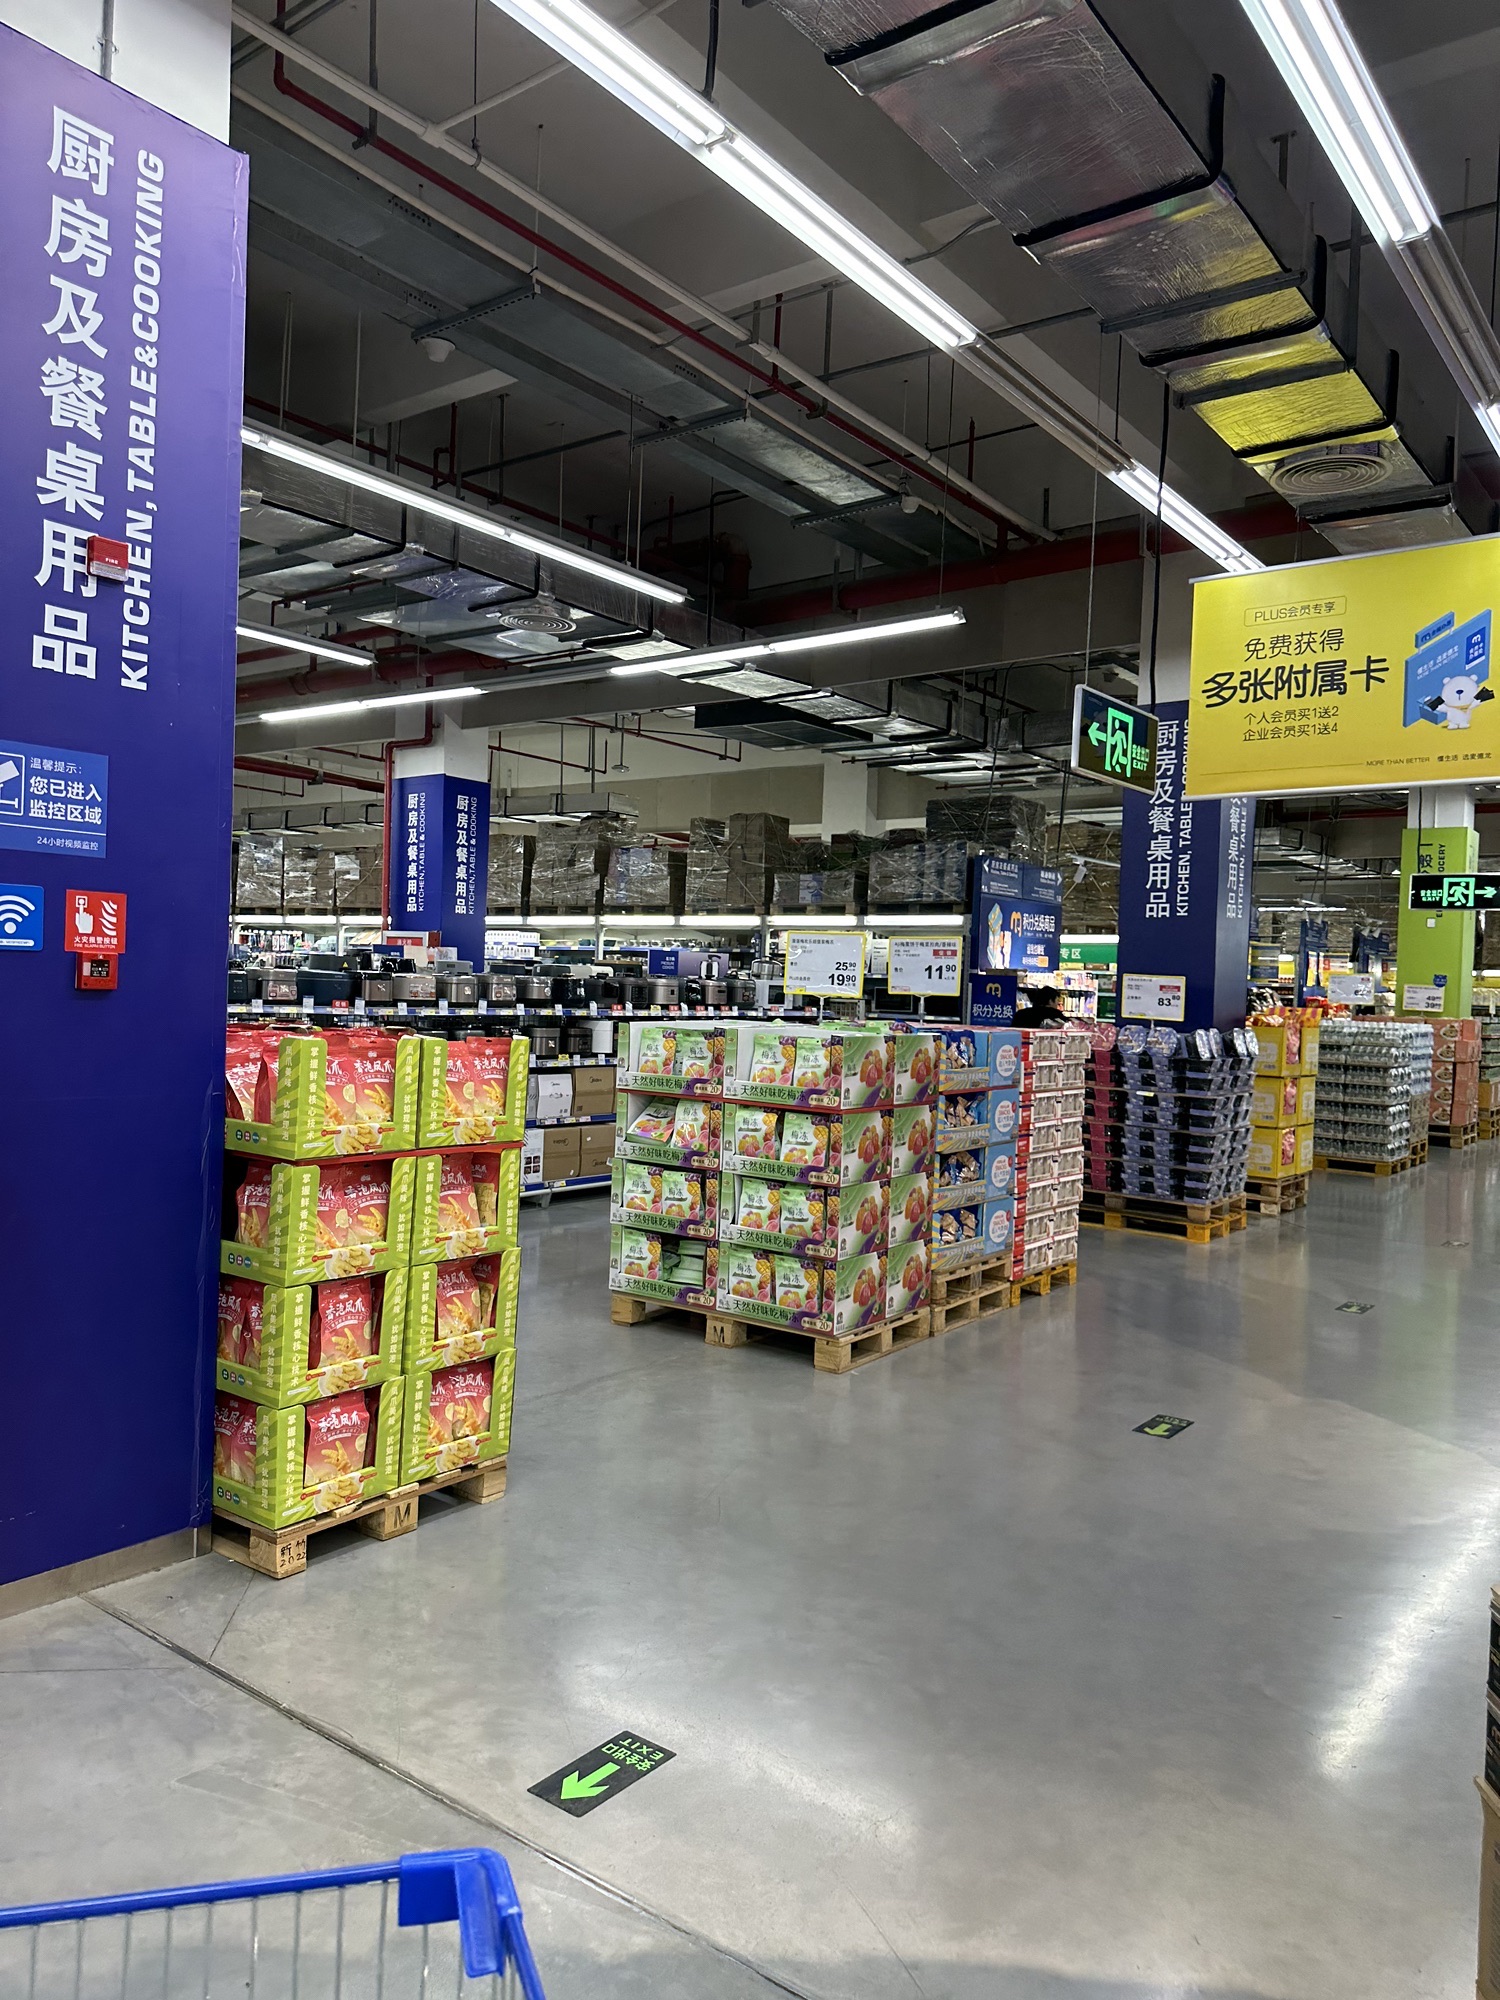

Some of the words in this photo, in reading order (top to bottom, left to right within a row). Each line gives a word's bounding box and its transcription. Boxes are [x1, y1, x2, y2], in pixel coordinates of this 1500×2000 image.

[32, 105, 115, 680] 厨房及餐桌用品
[105, 557, 119, 565] FIRE
[121, 501, 158, 692] KITCHEN,
[1254, 602, 1336, 623] PLUS会员专享
[1244, 628, 1345, 662] 免费获得
[1201, 655, 1390, 709] 多张附属卡
[1243, 705, 1340, 726] 个人会员买1送2
[1242, 722, 1339, 742] 企业会员买1送4
[1132, 759, 1148, 772] EXIT
[1406, 757, 1430, 765] BETTER
[29, 776, 103, 803] 您已进入
[28, 799, 103, 825] 监控区域
[419, 792, 427, 832] COOKING
[470, 796, 478, 835] COOKING
[1145, 720, 1179, 918] 厨房及餐桌用品
[1179, 802, 1194, 848] TABLE
[36, 836, 99, 851] 24小时视频监控
[406, 793, 419, 912] 厨房及餐桌用品
[454, 794, 469, 914] 厨房及餐桌用品
[1176, 850, 1193, 917] KITCHEN,
[1023, 913, 1056, 932] 积分兑换商品
[74, 936, 118, 945] 火灾报警按钮
[1060, 948, 1082, 960] 专区
[972, 1003, 1014, 1018] 积分兑换
[689, 1046, 705, 1056] 梅冻
[761, 1050, 777, 1060] 梅冻
[802, 1054, 820, 1064] 梅冻
[354, 1059, 395, 1074] 香泡凤爪
[473, 1057, 508, 1071] 香泡凤爪
[307, 1047, 319, 1140] 掌握鲜香核心技术
[430, 1046, 442, 1131] 掌握鲜香核心技术
[632, 1075, 692, 1091] 天然好味吃梅冻
[709, 1085, 718, 1094] 20
[740, 1084, 806, 1102] 天然好味吃梅冻
[826, 1096, 835, 1106] 20
[683, 1106, 698, 1117] 梅冻
[742, 1117, 759, 1127] 梅冻
[791, 1130, 809, 1141] 梅冻
[630, 1145, 688, 1163] 天然好味吃梅冻
[706, 1158, 715, 1167] 20
[740, 1159, 806, 1178] 天然好味吃梅冻
[825, 1174, 835, 1183] 20
[344, 1181, 392, 1199] 香泡凤爪
[632, 1179, 648, 1190] 梅冻
[668, 1186, 684, 1197] 梅冻
[421, 1162, 435, 1248] 掌握鲜香核心技术
[747, 1193, 764, 1204] 梅冻
[296, 1173, 311, 1268] 掌握鲜香核心技术
[787, 1206, 804, 1218] 梅冻
[625, 1211, 684, 1232] 天然好味吃梅冻
[702, 1227, 711, 1237] 20
[629, 1245, 644, 1255] 梅冻
[736, 1229, 803, 1251] 天然好味吃梅冻
[823, 1248, 832, 1257] 20
[736, 1262, 753, 1274] 梅冻
[782, 1272, 801, 1284] 梅冻
[624, 1277, 685, 1299] 天然好味吃梅冻
[702, 1297, 711, 1306] 20
[326, 1297, 365, 1320] 香泡凤爪
[419, 1271, 431, 1358] 掌握鲜香核心技术
[733, 1299, 799, 1324] 天然好味吃梅冻
[819, 1321, 828, 1331] 20
[290, 1293, 304, 1388] 掌握鲜香核心技术
[713, 1325, 726, 1344] M
[318, 1410, 361, 1433] 香泡凤爪
[411, 1380, 424, 1466] 掌握鲜香核心技术
[285, 1414, 297, 1508] 掌握鲜香核心技术
[393, 1502, 411, 1529] M
[279, 1551, 306, 1568] 2022
[601, 1743, 656, 1772] 安全出口
[619, 1738, 665, 1761] EXIT
